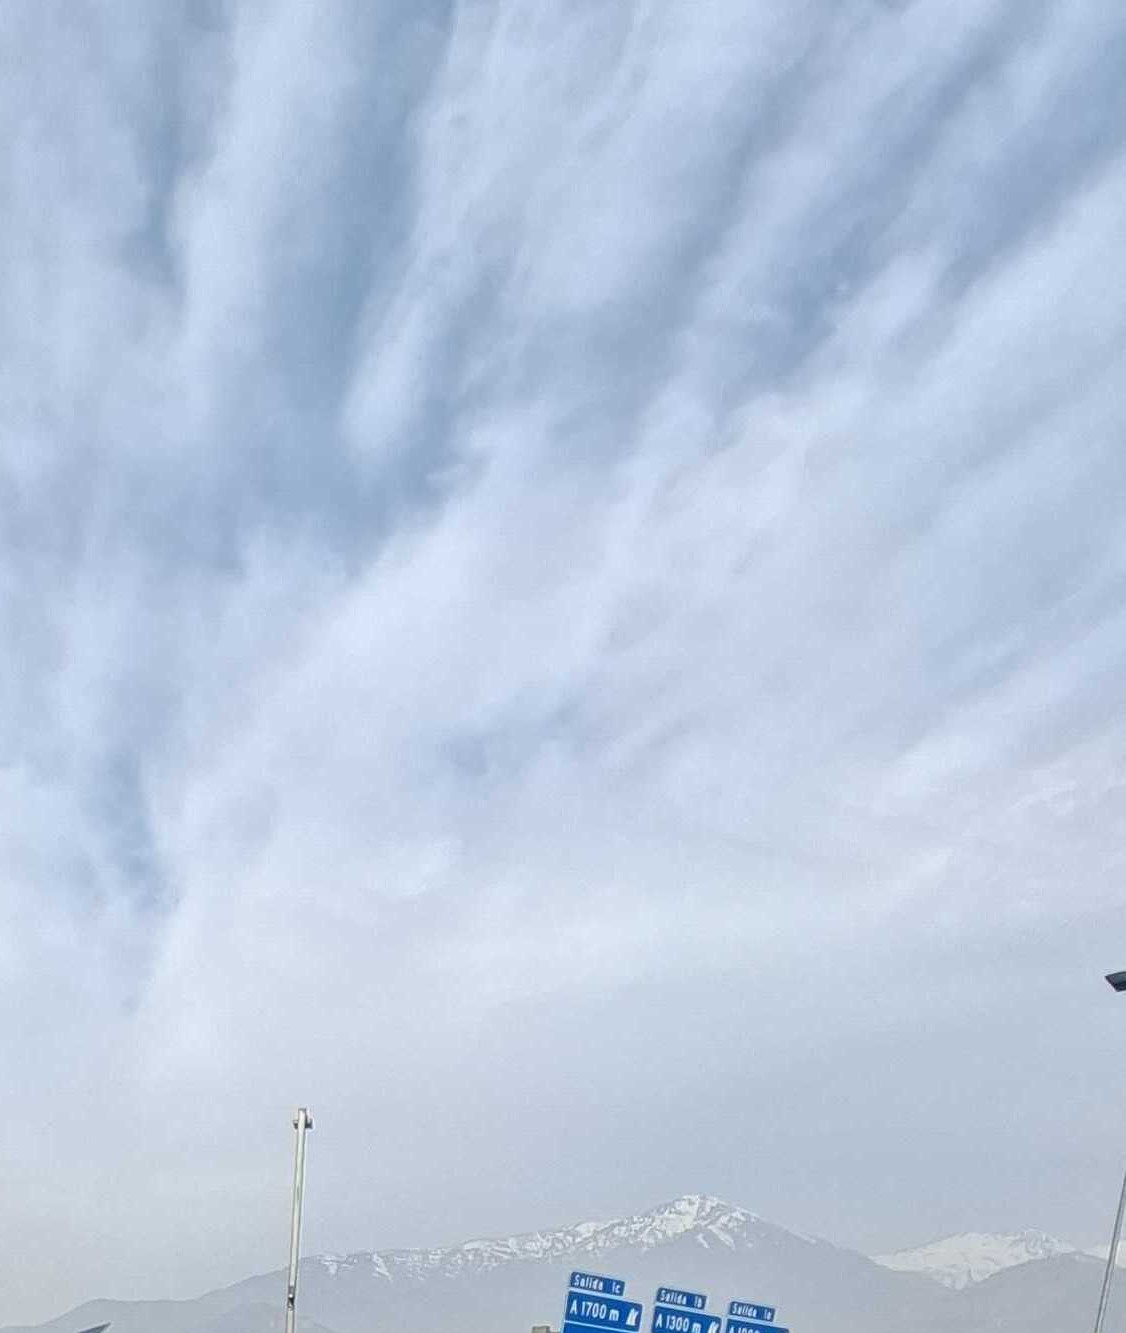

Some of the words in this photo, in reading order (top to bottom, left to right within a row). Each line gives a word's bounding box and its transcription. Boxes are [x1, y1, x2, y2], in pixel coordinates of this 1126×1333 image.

[574, 1274, 603, 1290] Salida
[660, 1289, 687, 1305] Salida
[570, 1299, 578, 1315] A
[581, 1301, 607, 1320] 1700
[609, 1309, 620, 1322] m
[732, 1303, 757, 1318] Salida
[655, 1313, 663, 1328] A
[666, 1314, 690, 1333] 1300
